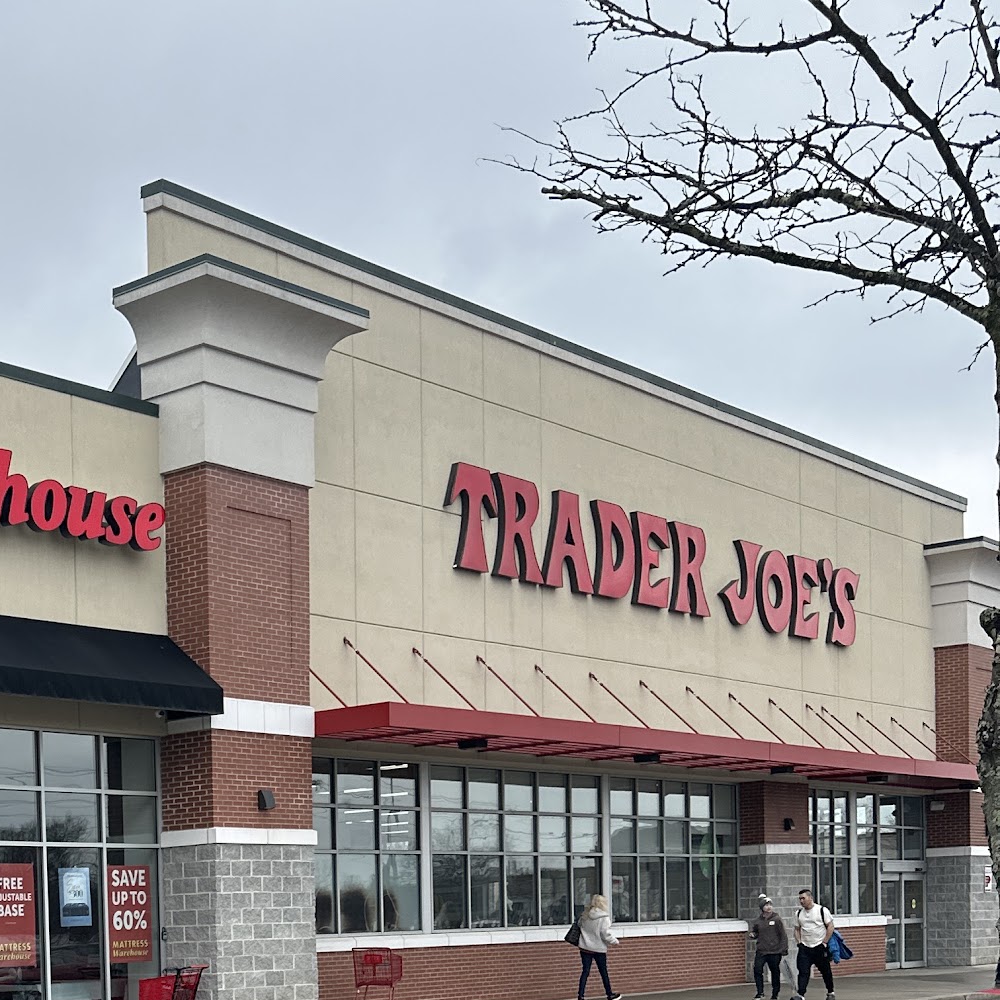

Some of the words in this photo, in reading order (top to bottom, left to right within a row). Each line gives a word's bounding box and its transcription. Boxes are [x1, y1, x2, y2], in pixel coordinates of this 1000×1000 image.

[443, 461, 711, 618] TRADER
[717, 539, 861, 648] JOE'S
[111, 869, 146, 887] SAVE
[111, 891, 129, 906] UP
[130, 890, 147, 906] TO
[112, 909, 148, 931] 60%
[112, 939, 149, 949] MATTRESS
